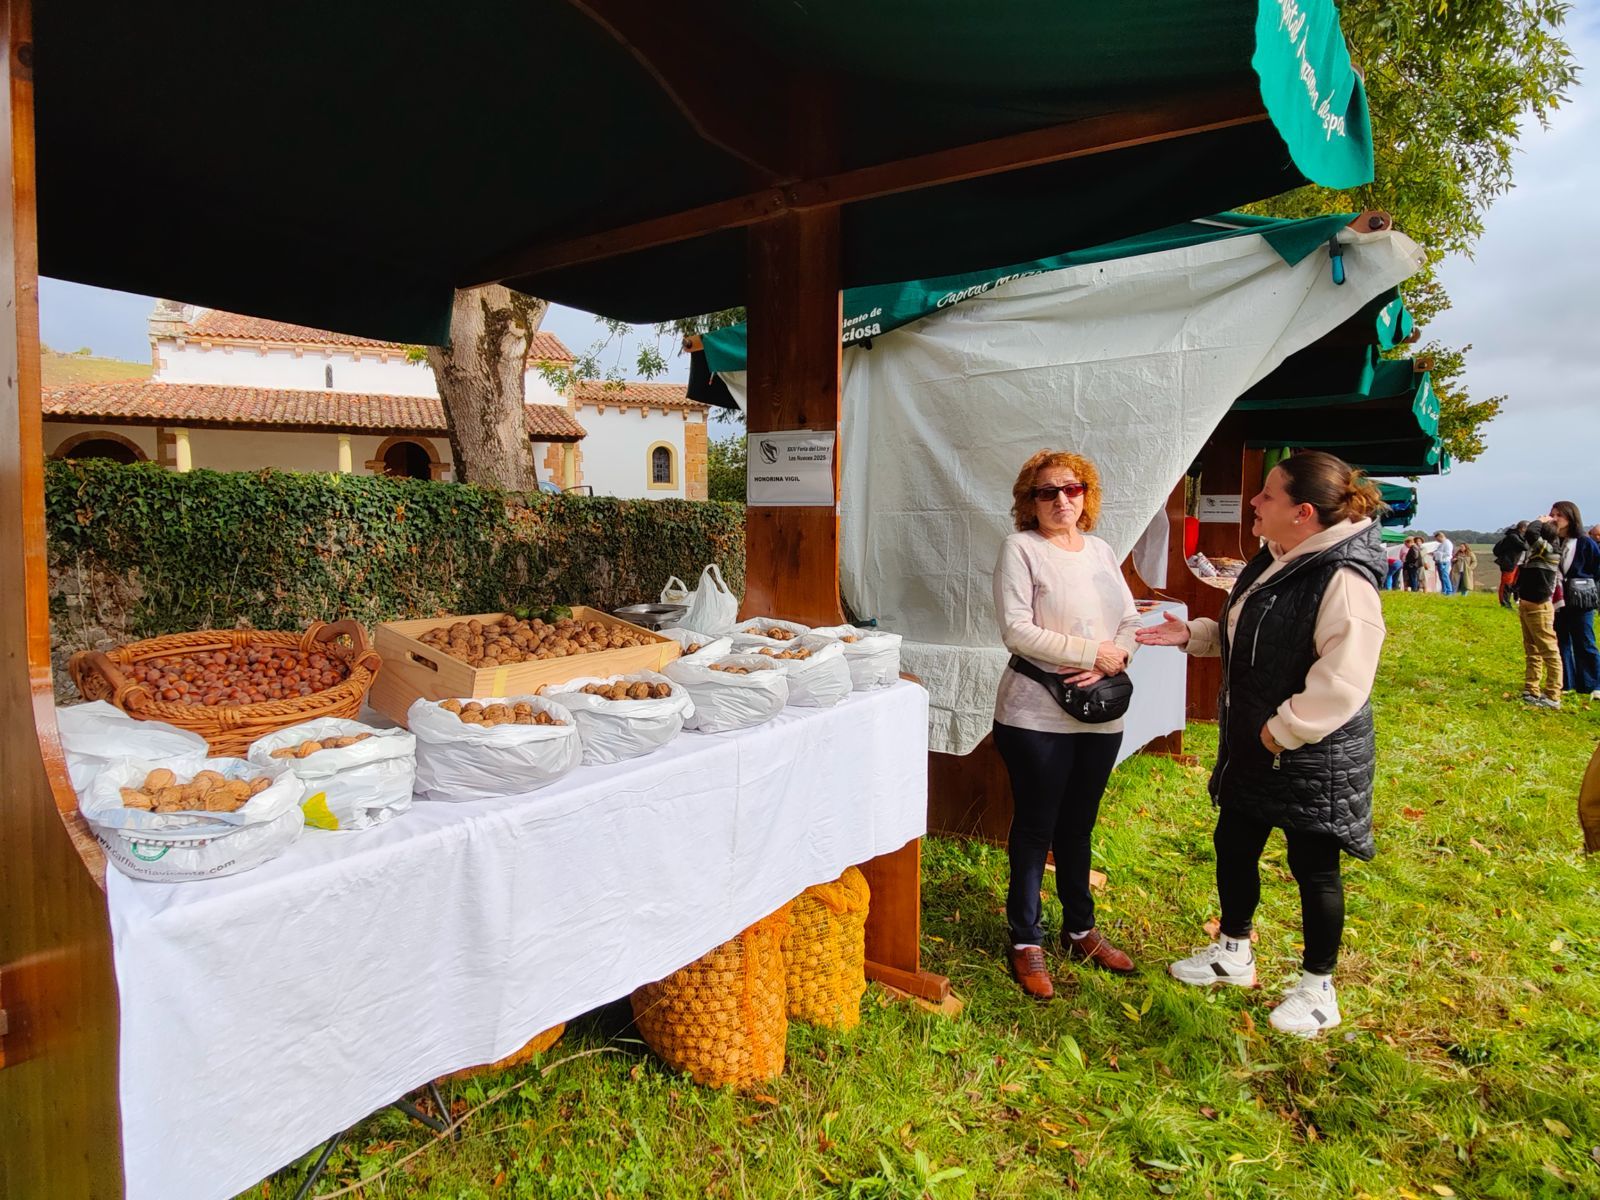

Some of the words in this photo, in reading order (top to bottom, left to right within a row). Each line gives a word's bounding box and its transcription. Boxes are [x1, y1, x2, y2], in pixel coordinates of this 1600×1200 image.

[843, 313, 869, 329] iento
[870, 307, 882, 318] de
[842, 322, 882, 342] ciosa
